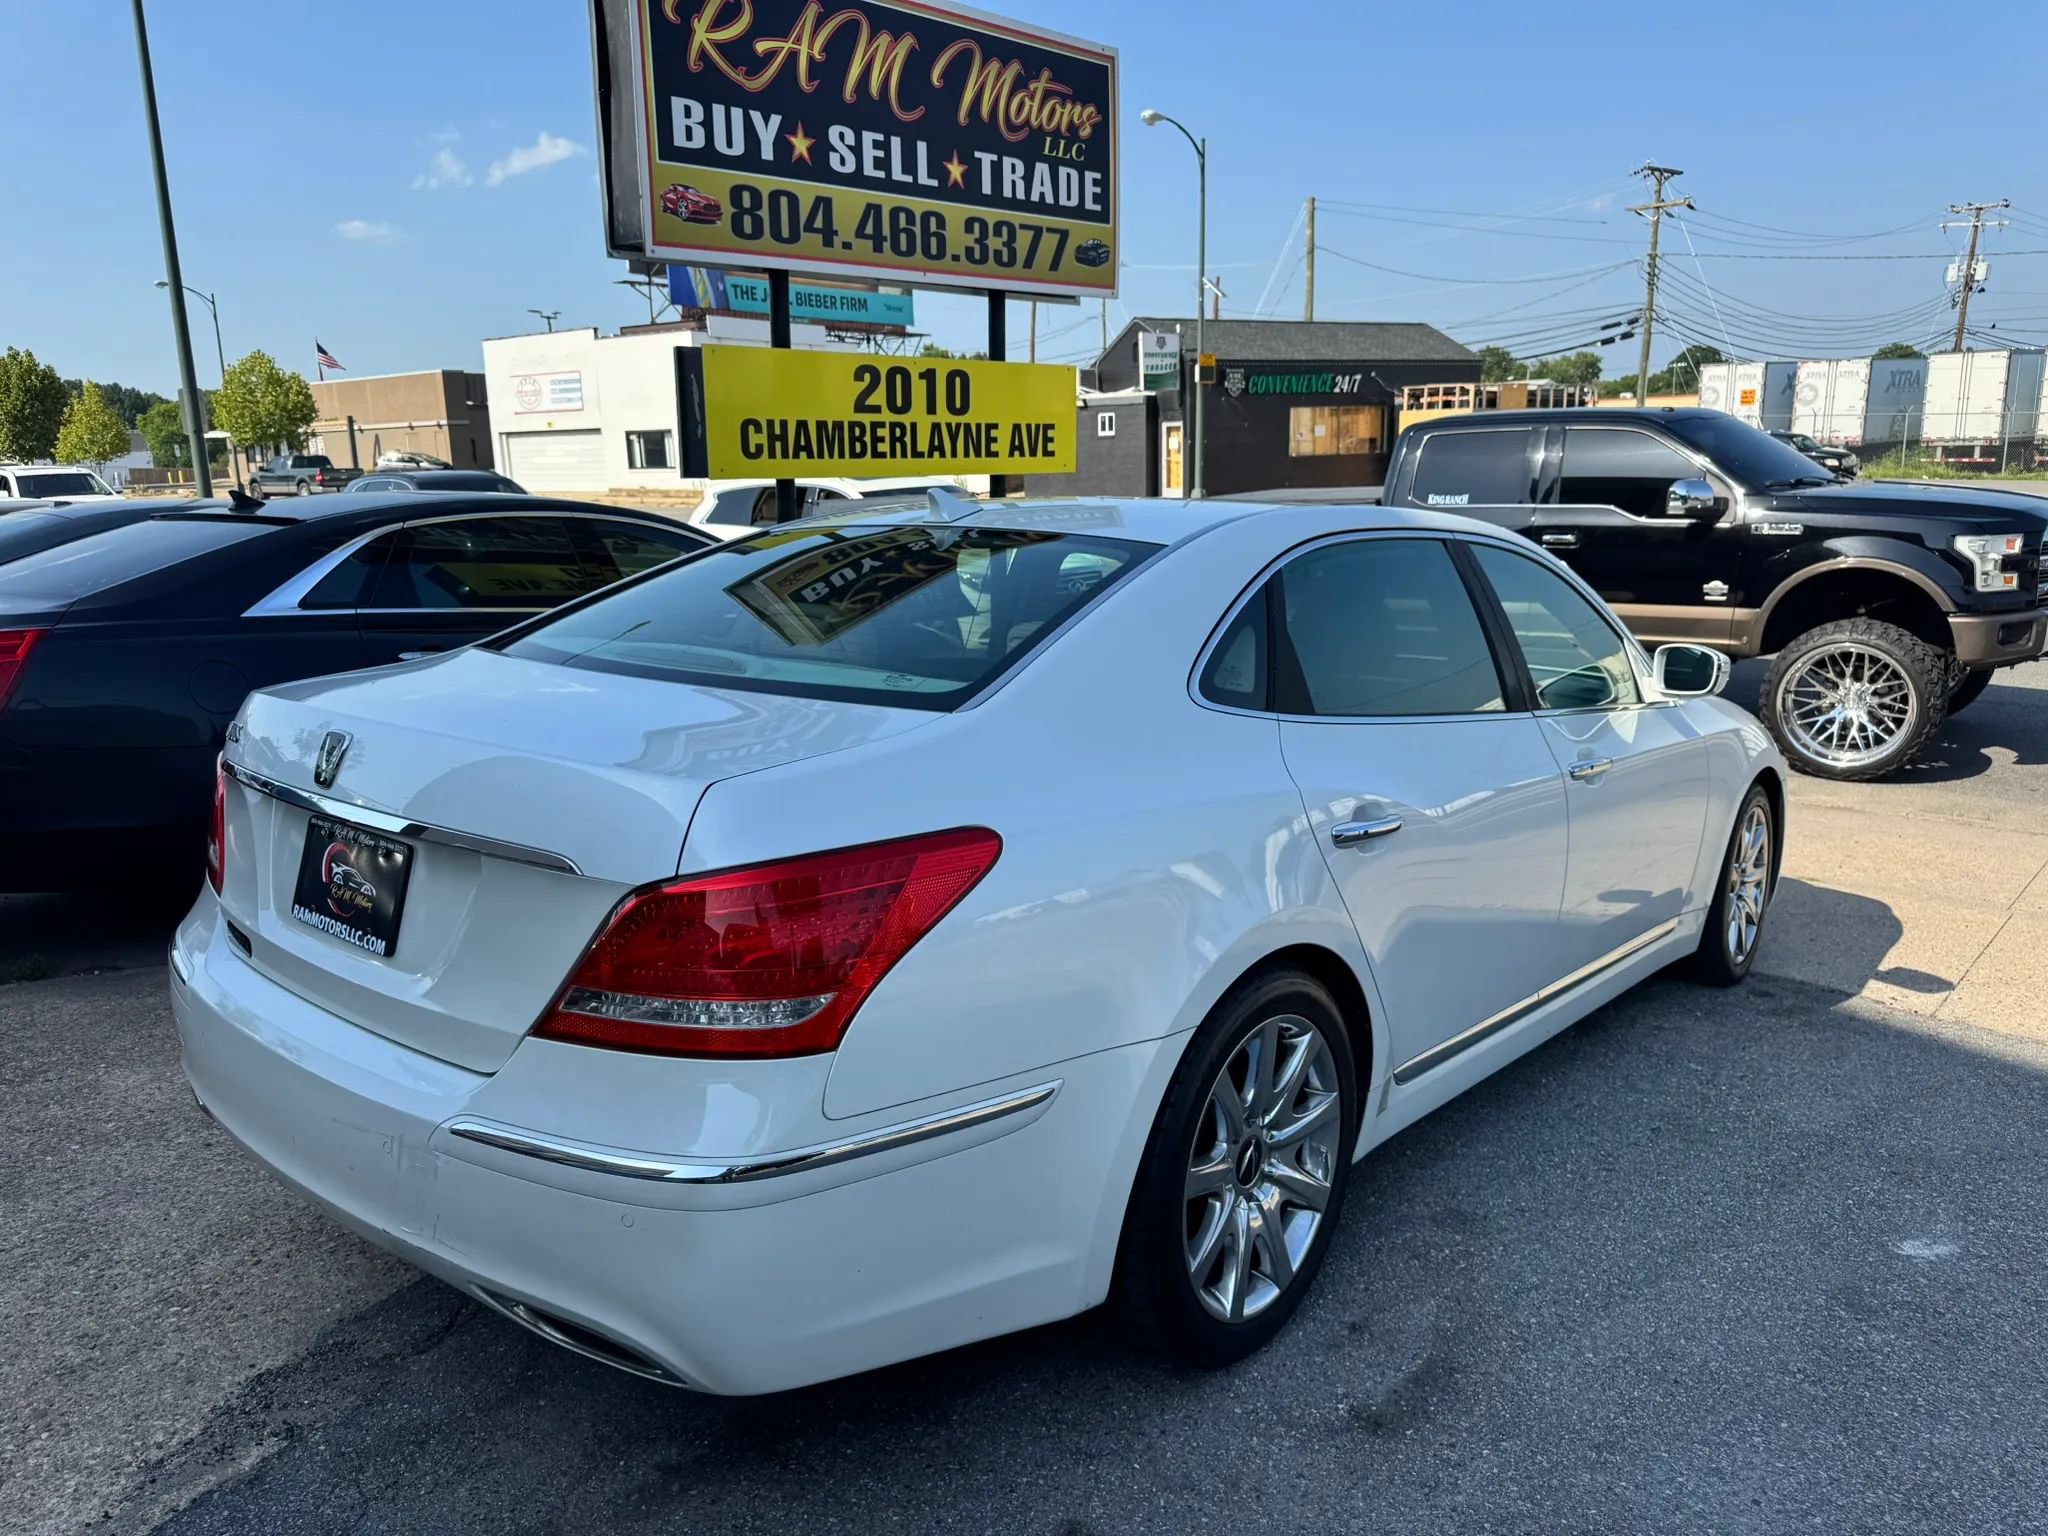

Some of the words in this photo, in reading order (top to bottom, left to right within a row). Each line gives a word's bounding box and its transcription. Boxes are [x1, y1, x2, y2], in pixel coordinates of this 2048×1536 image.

[931, 39, 1103, 142] Motors
[671, 96, 782, 160] BUY
[827, 125, 938, 187] SELL
[974, 150, 1102, 212] TRADE
[1042, 137, 1086, 162] LLC
[728, 184, 1069, 272] 804.466.3377
[731, 284, 757, 302] THE
[796, 292, 838, 312] BIEBER
[840, 297, 869, 313] FIRM
[853, 364, 971, 416] 2010
[1247, 373, 1335, 394] CONVENIENCE
[1333, 373, 1362, 393] 24/7
[1884, 369, 1921, 393] XTRA
[740, 418, 999, 461] CHAMBERLAYNE
[1008, 423, 1056, 458] AVE
